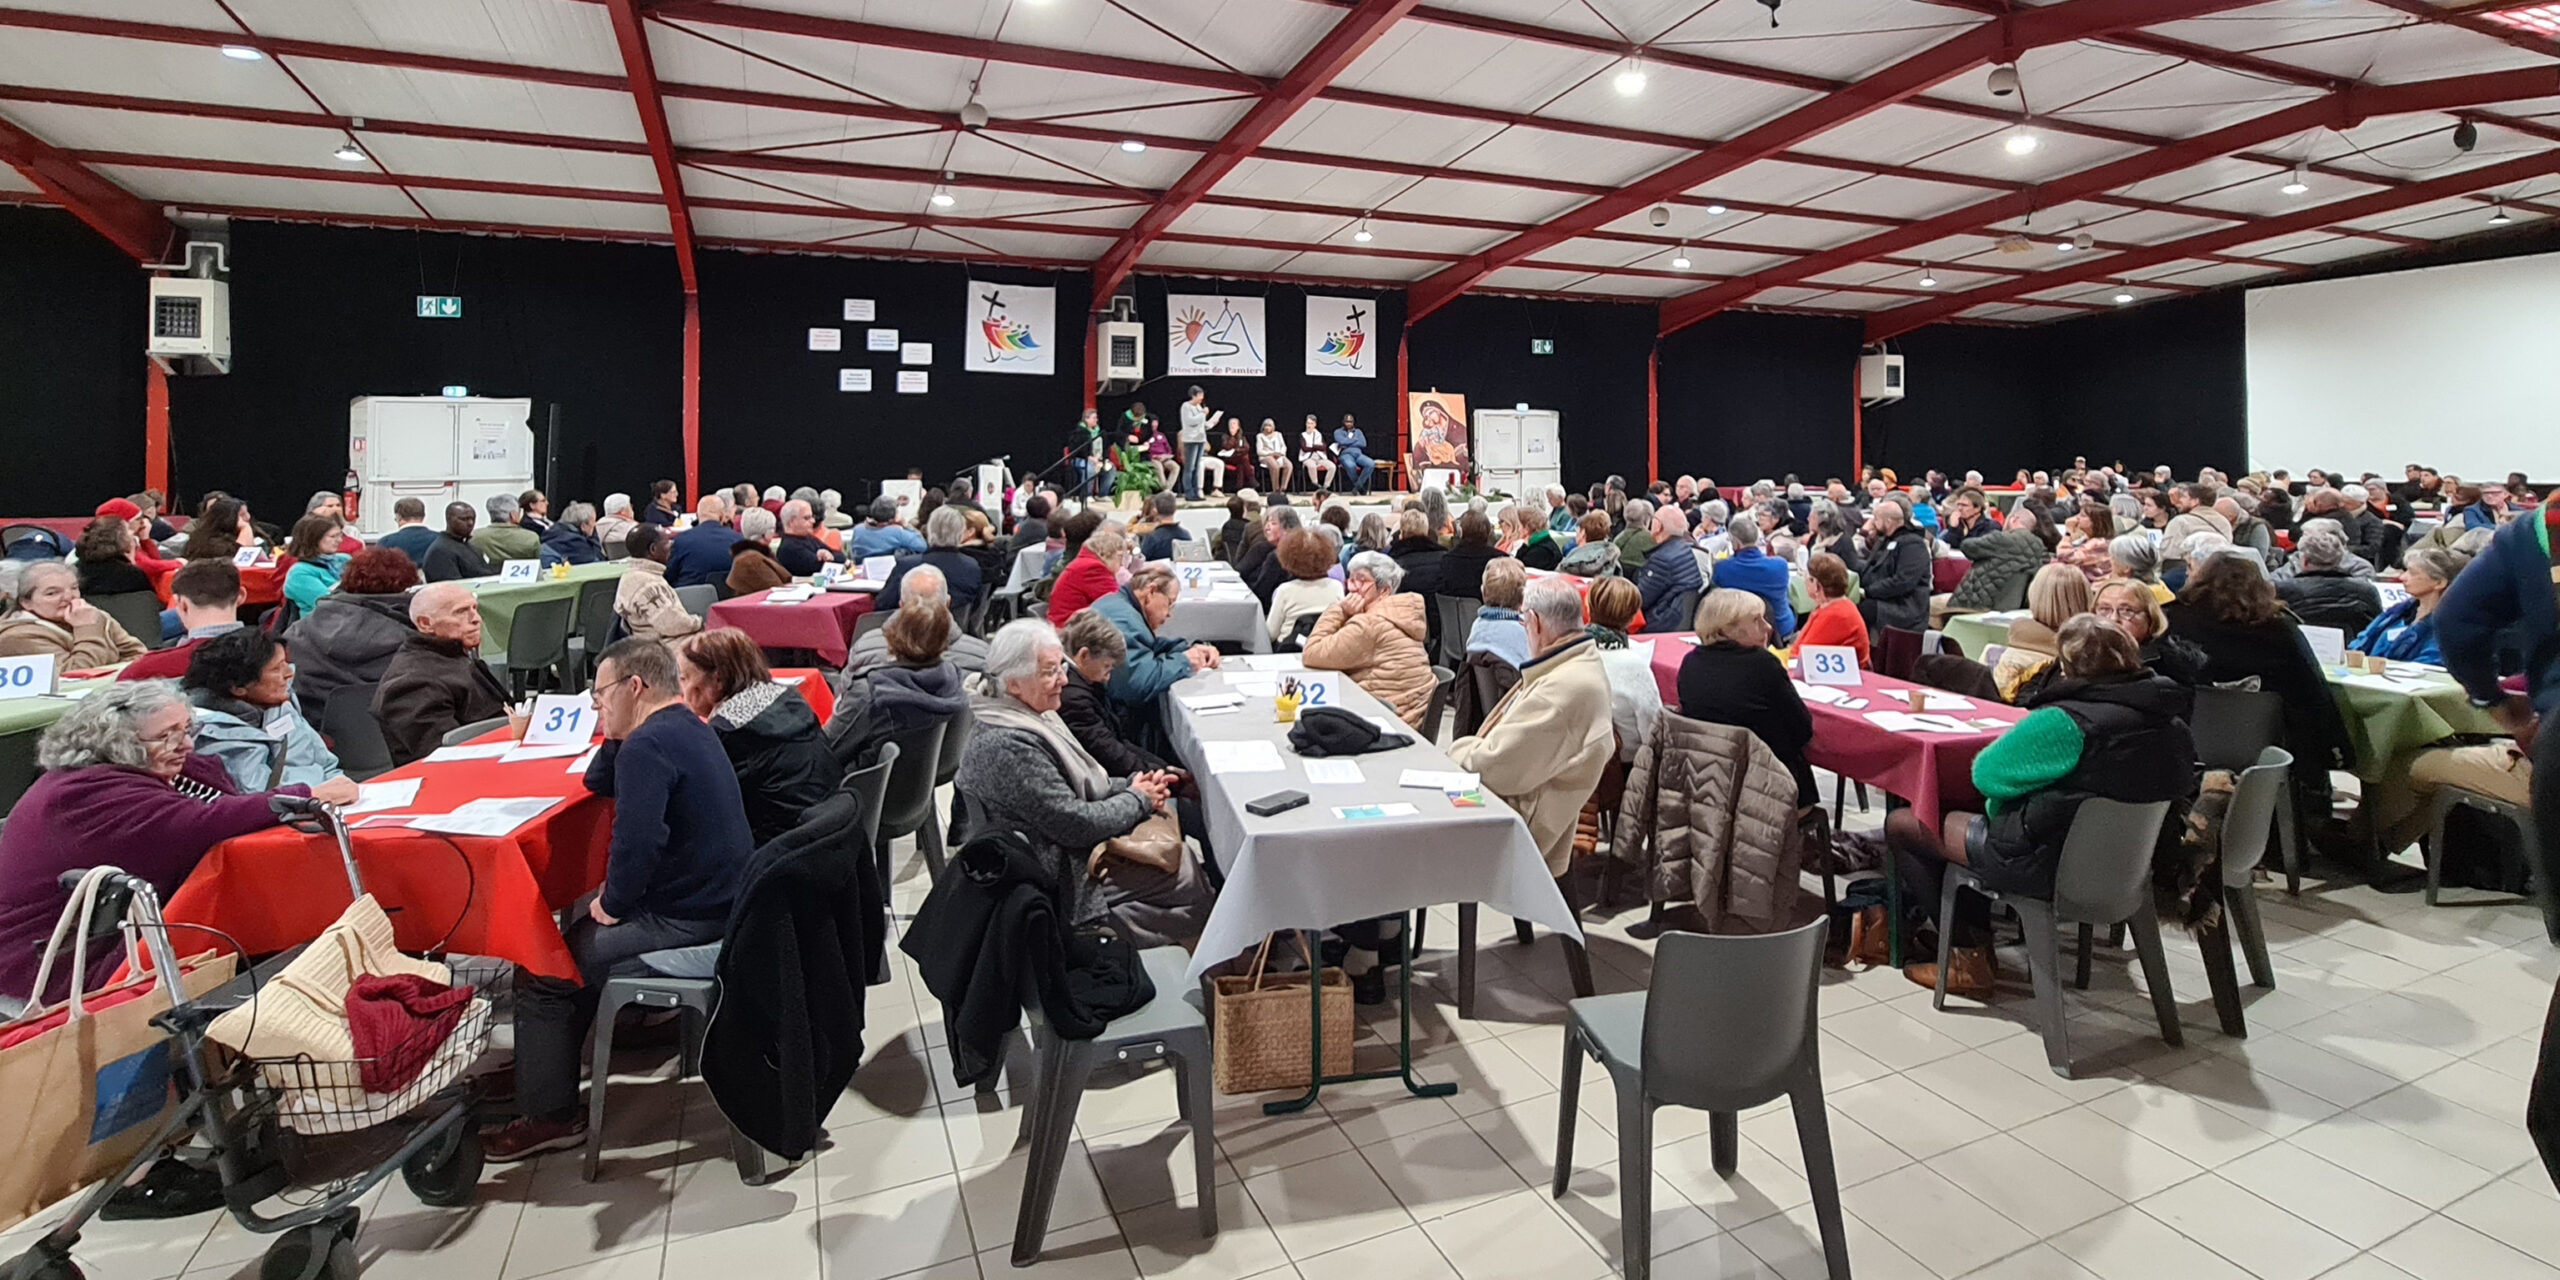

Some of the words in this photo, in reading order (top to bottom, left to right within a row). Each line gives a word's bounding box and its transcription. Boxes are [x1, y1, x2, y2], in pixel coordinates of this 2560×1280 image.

[1212, 366, 1223, 374] de
[1225, 366, 1265, 375] Pamiers
[510, 564, 530, 577] 24
[1184, 567, 1203, 579] 22
[2383, 588, 2409, 601] 35
[1815, 653, 1846, 674] 33
[545, 706, 582, 732] 31
